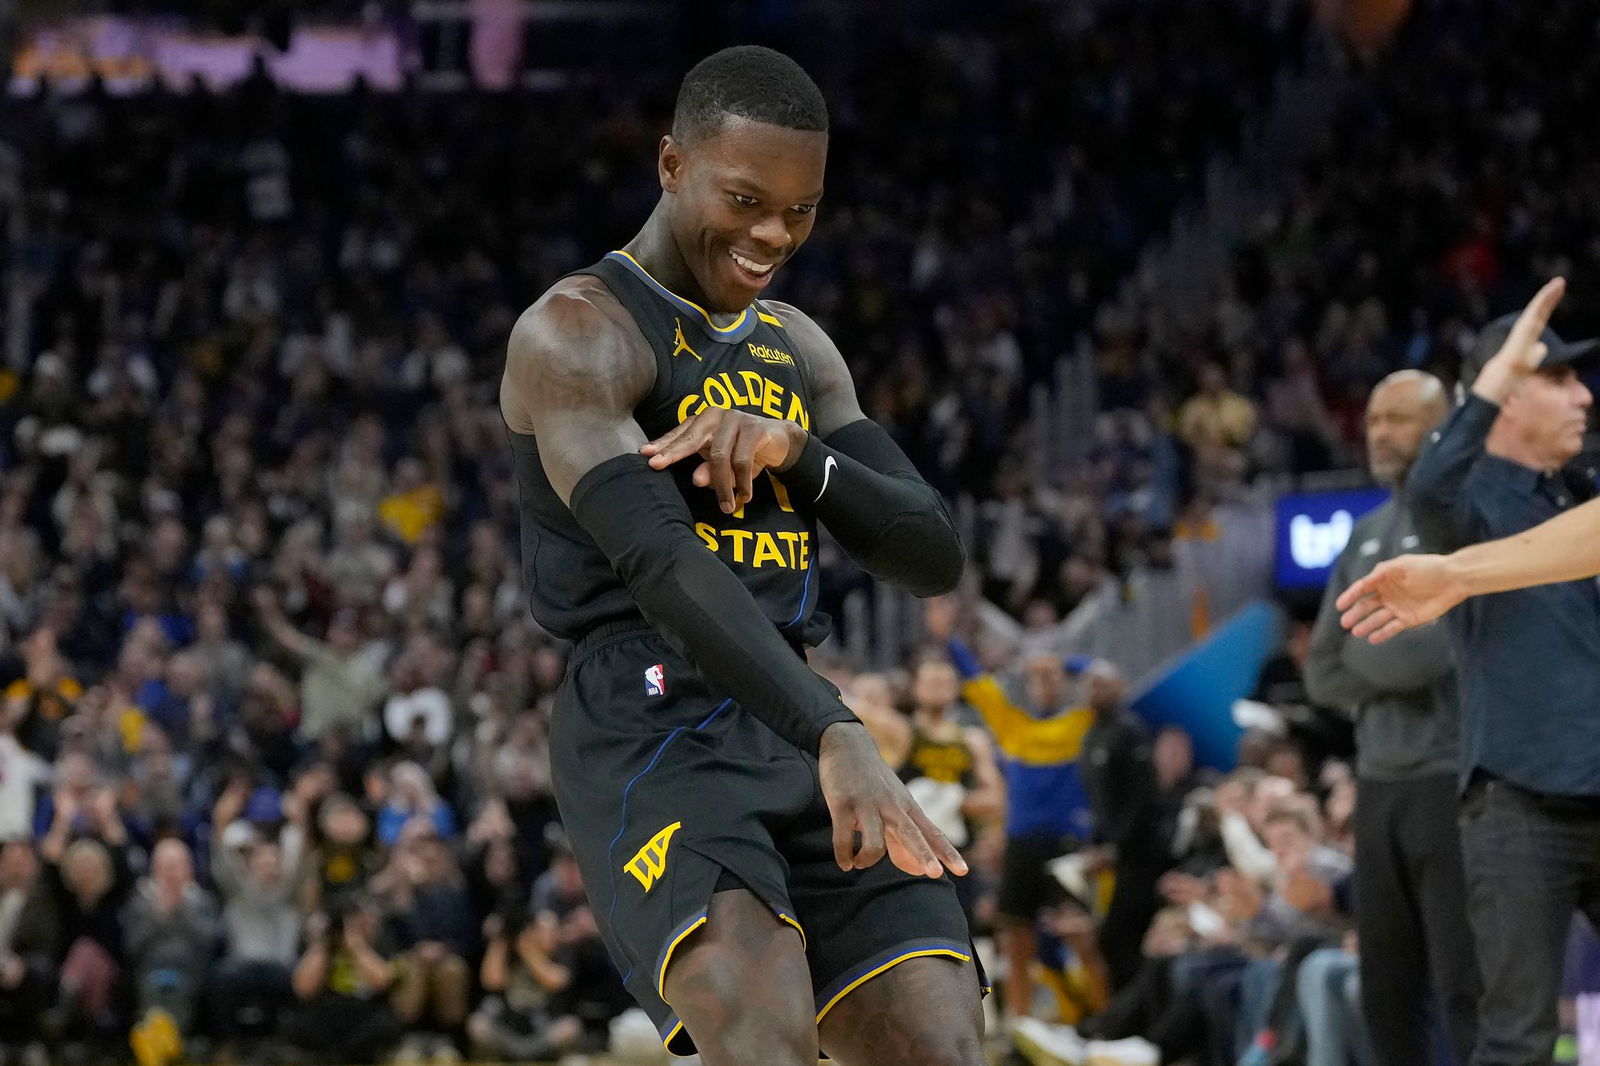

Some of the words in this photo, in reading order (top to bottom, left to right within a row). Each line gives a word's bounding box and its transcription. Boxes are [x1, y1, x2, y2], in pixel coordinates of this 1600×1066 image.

[747, 343, 795, 366] Rakuten
[677, 371, 809, 431] GOLDEN
[695, 522, 809, 571] STATE
